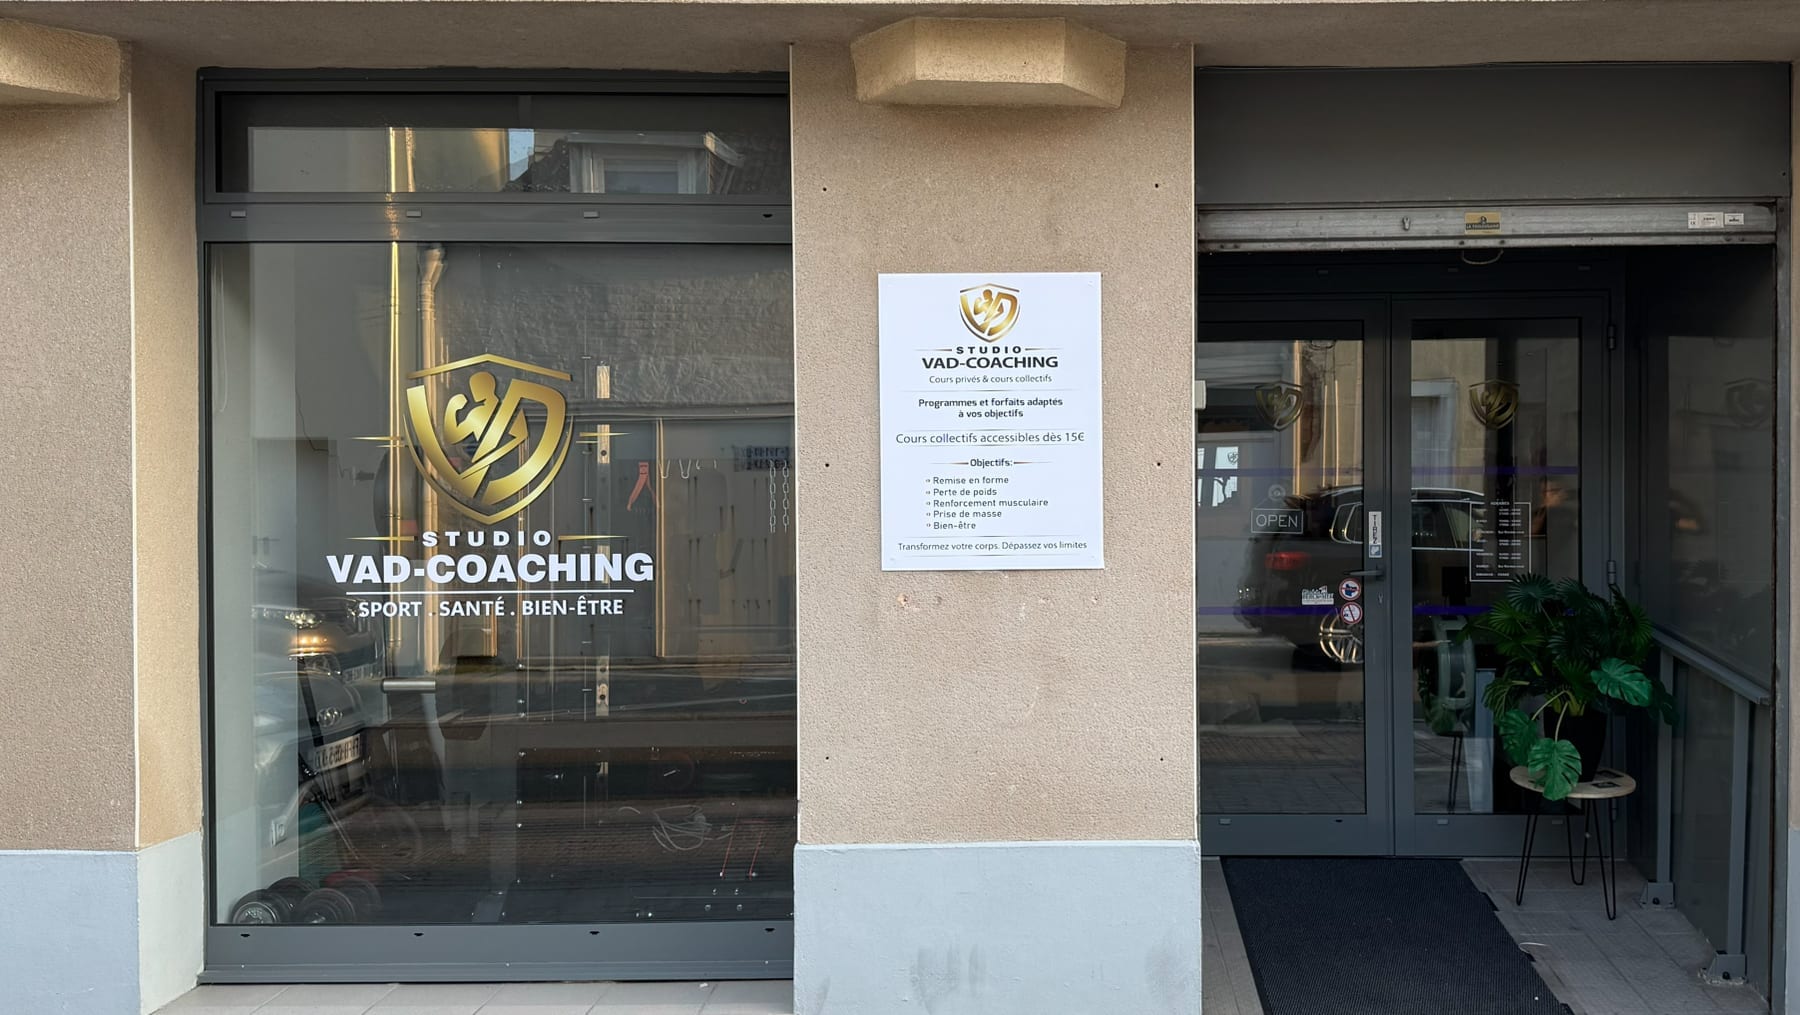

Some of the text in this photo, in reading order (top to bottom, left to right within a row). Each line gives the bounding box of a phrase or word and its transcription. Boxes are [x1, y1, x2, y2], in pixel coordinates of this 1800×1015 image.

[956, 346, 1022, 354] STUDIO
[922, 356, 1058, 368] VAD-COACHING
[956, 375, 980, 384] privés
[1015, 374, 1052, 382] collectifs
[918, 399, 977, 409] Programmes
[991, 398, 1025, 406] forfaits
[1027, 398, 1063, 408] adaptés
[958, 409, 964, 417] à
[984, 409, 1024, 419] objectifs
[896, 432, 1084, 443] Cours collectifs accessibles dès 15€
[970, 458, 1012, 468] Objectifs:
[973, 488, 997, 497] poids
[934, 521, 976, 529] Bien-être
[1256, 514, 1298, 528] OPEN
[422, 530, 552, 547] STUDIO
[898, 542, 949, 551] Transformez
[1002, 541, 1040, 551] Dépassez
[326, 552, 655, 583] VAD-COACHING
[358, 596, 624, 618] SPORT SANTÉ BIEN-ÊTRE
